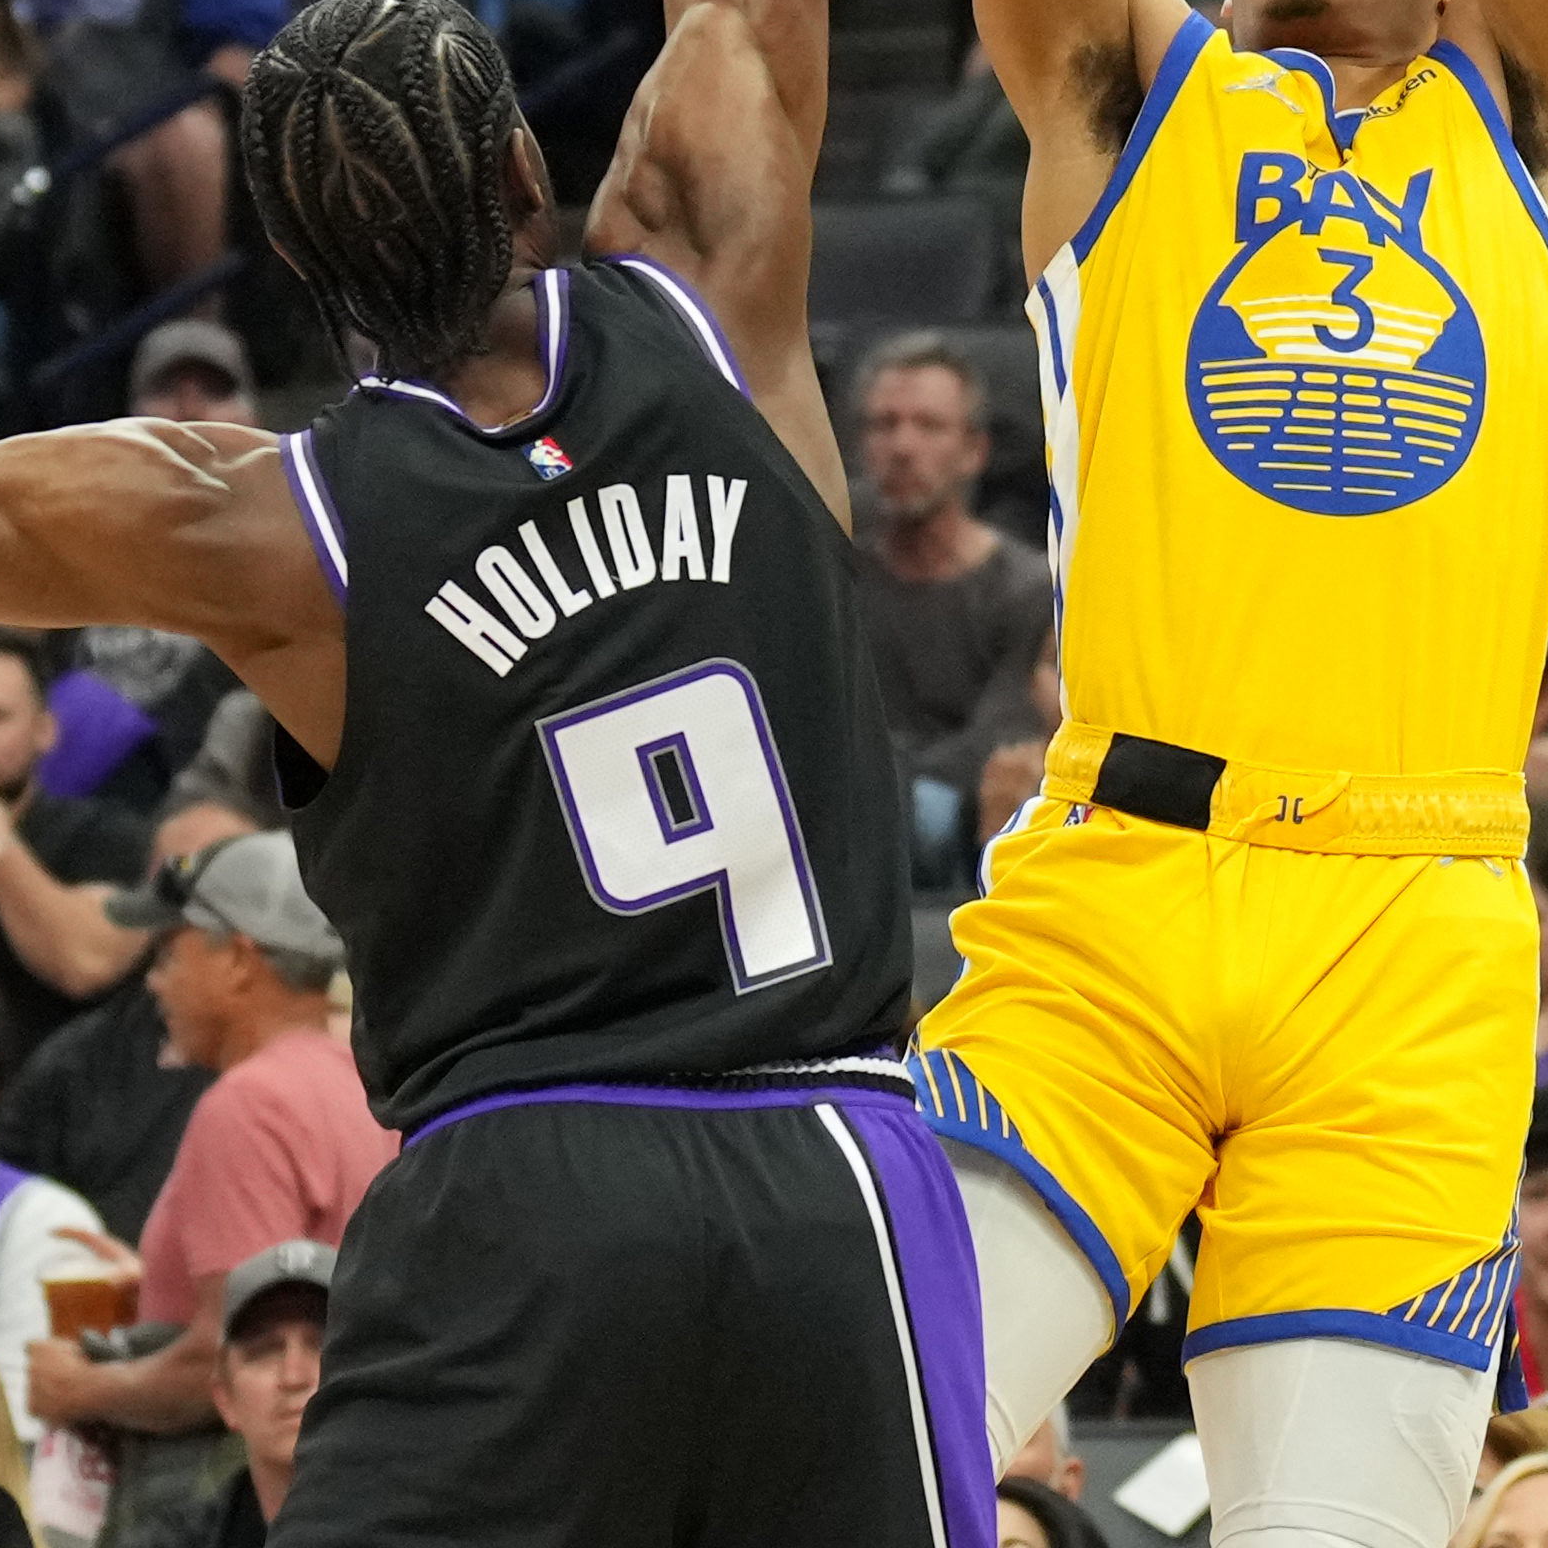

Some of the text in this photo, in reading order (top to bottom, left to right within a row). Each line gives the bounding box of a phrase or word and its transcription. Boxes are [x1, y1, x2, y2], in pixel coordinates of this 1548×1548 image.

[1235, 152, 1434, 249] BAY
[1313, 247, 1375, 353] 3
[425, 474, 748, 677] HOLIDAY
[535, 657, 834, 995] 9
